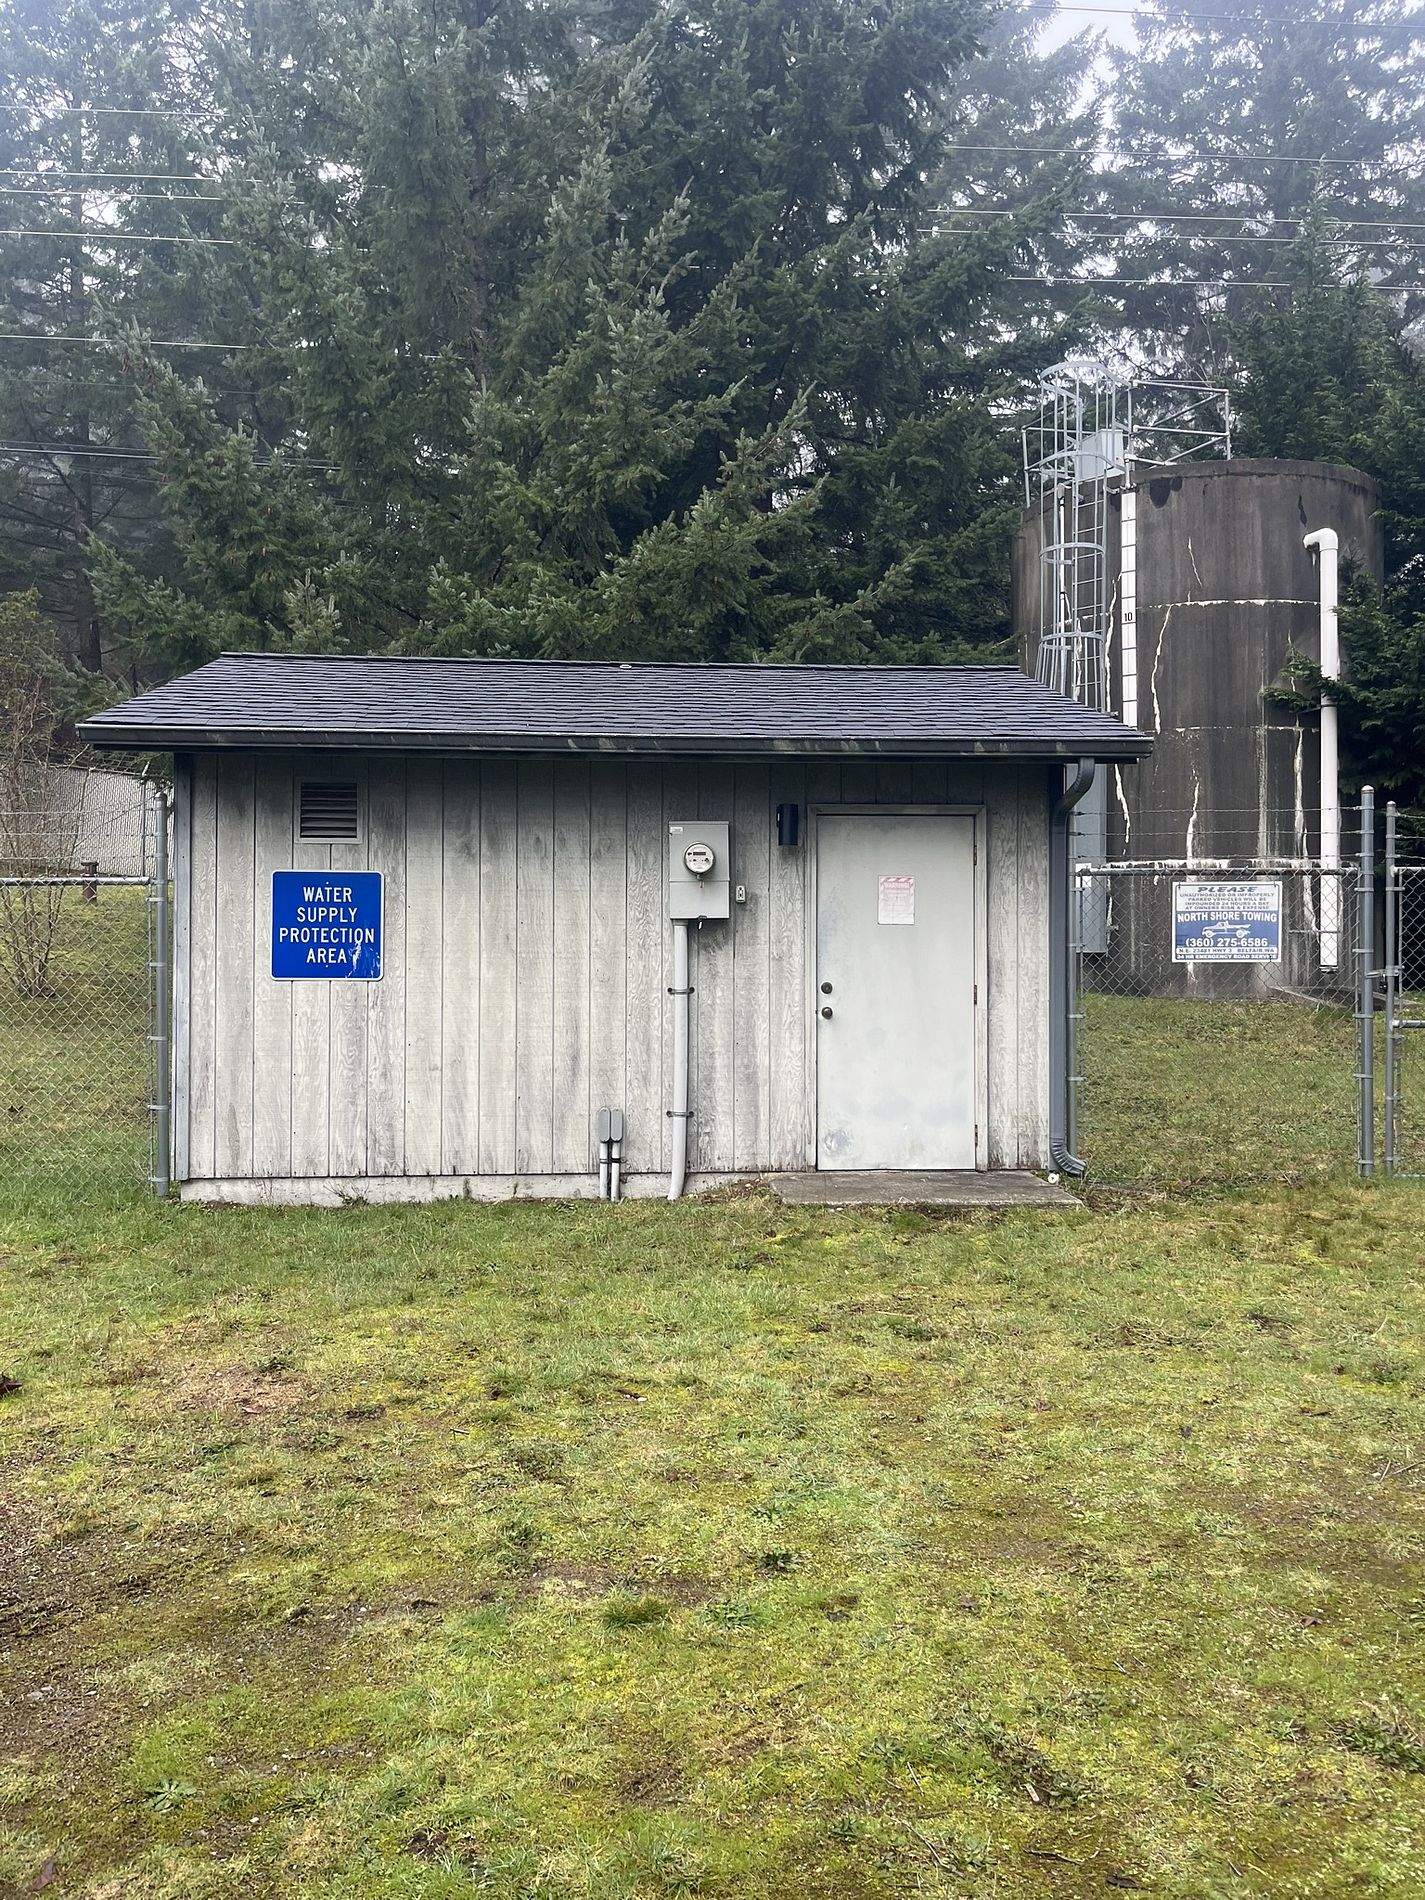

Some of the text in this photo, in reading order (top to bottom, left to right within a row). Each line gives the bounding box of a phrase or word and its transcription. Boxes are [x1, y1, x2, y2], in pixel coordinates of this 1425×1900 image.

[1124, 611, 1133, 621] 10
[303, 886, 352, 902] WATER
[296, 906, 358, 922] SUPPLY
[1177, 911, 1278, 923] NORTH SHORE TOWING
[279, 927, 375, 943] PROTECTION
[1185, 937, 1268, 947] (360) 275-6586
[306, 947, 347, 963] AREA
